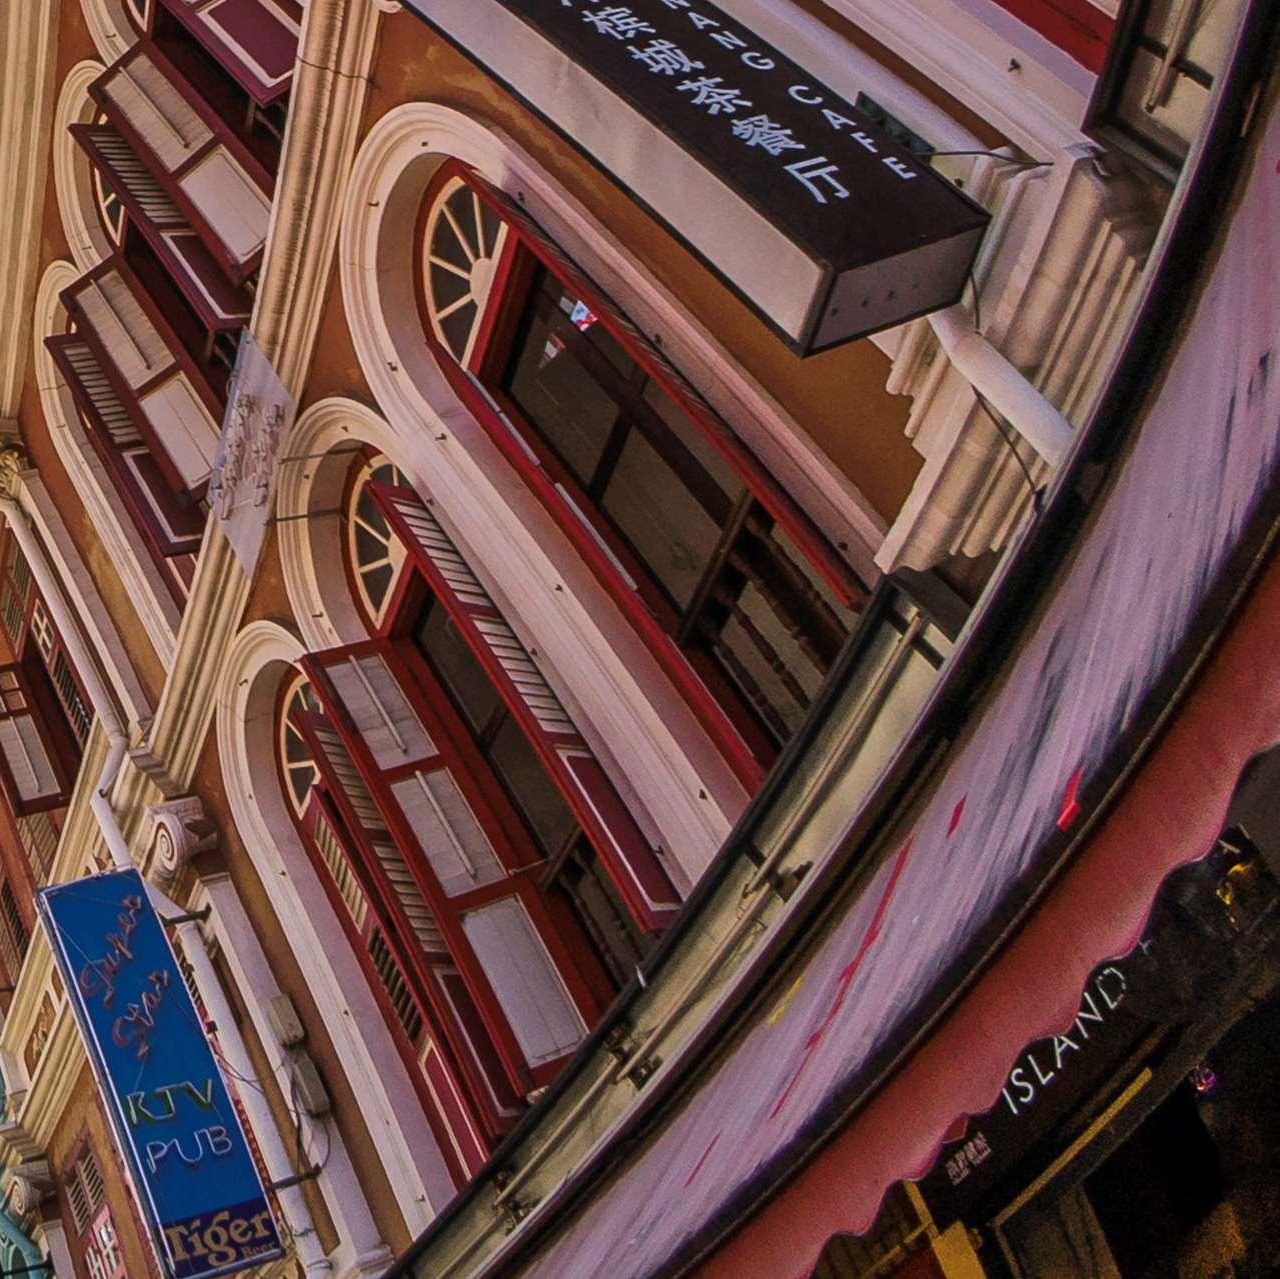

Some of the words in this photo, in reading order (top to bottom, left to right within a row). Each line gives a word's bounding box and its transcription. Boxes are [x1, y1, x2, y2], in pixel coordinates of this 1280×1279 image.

[789, 84, 917, 180] CAFE
[1002, 967, 1127, 1115] ISLAND
[126, 1078, 213, 1125] KTV
[146, 1126, 233, 1174] PUB
[165, 1211, 271, 1267] Tiger
